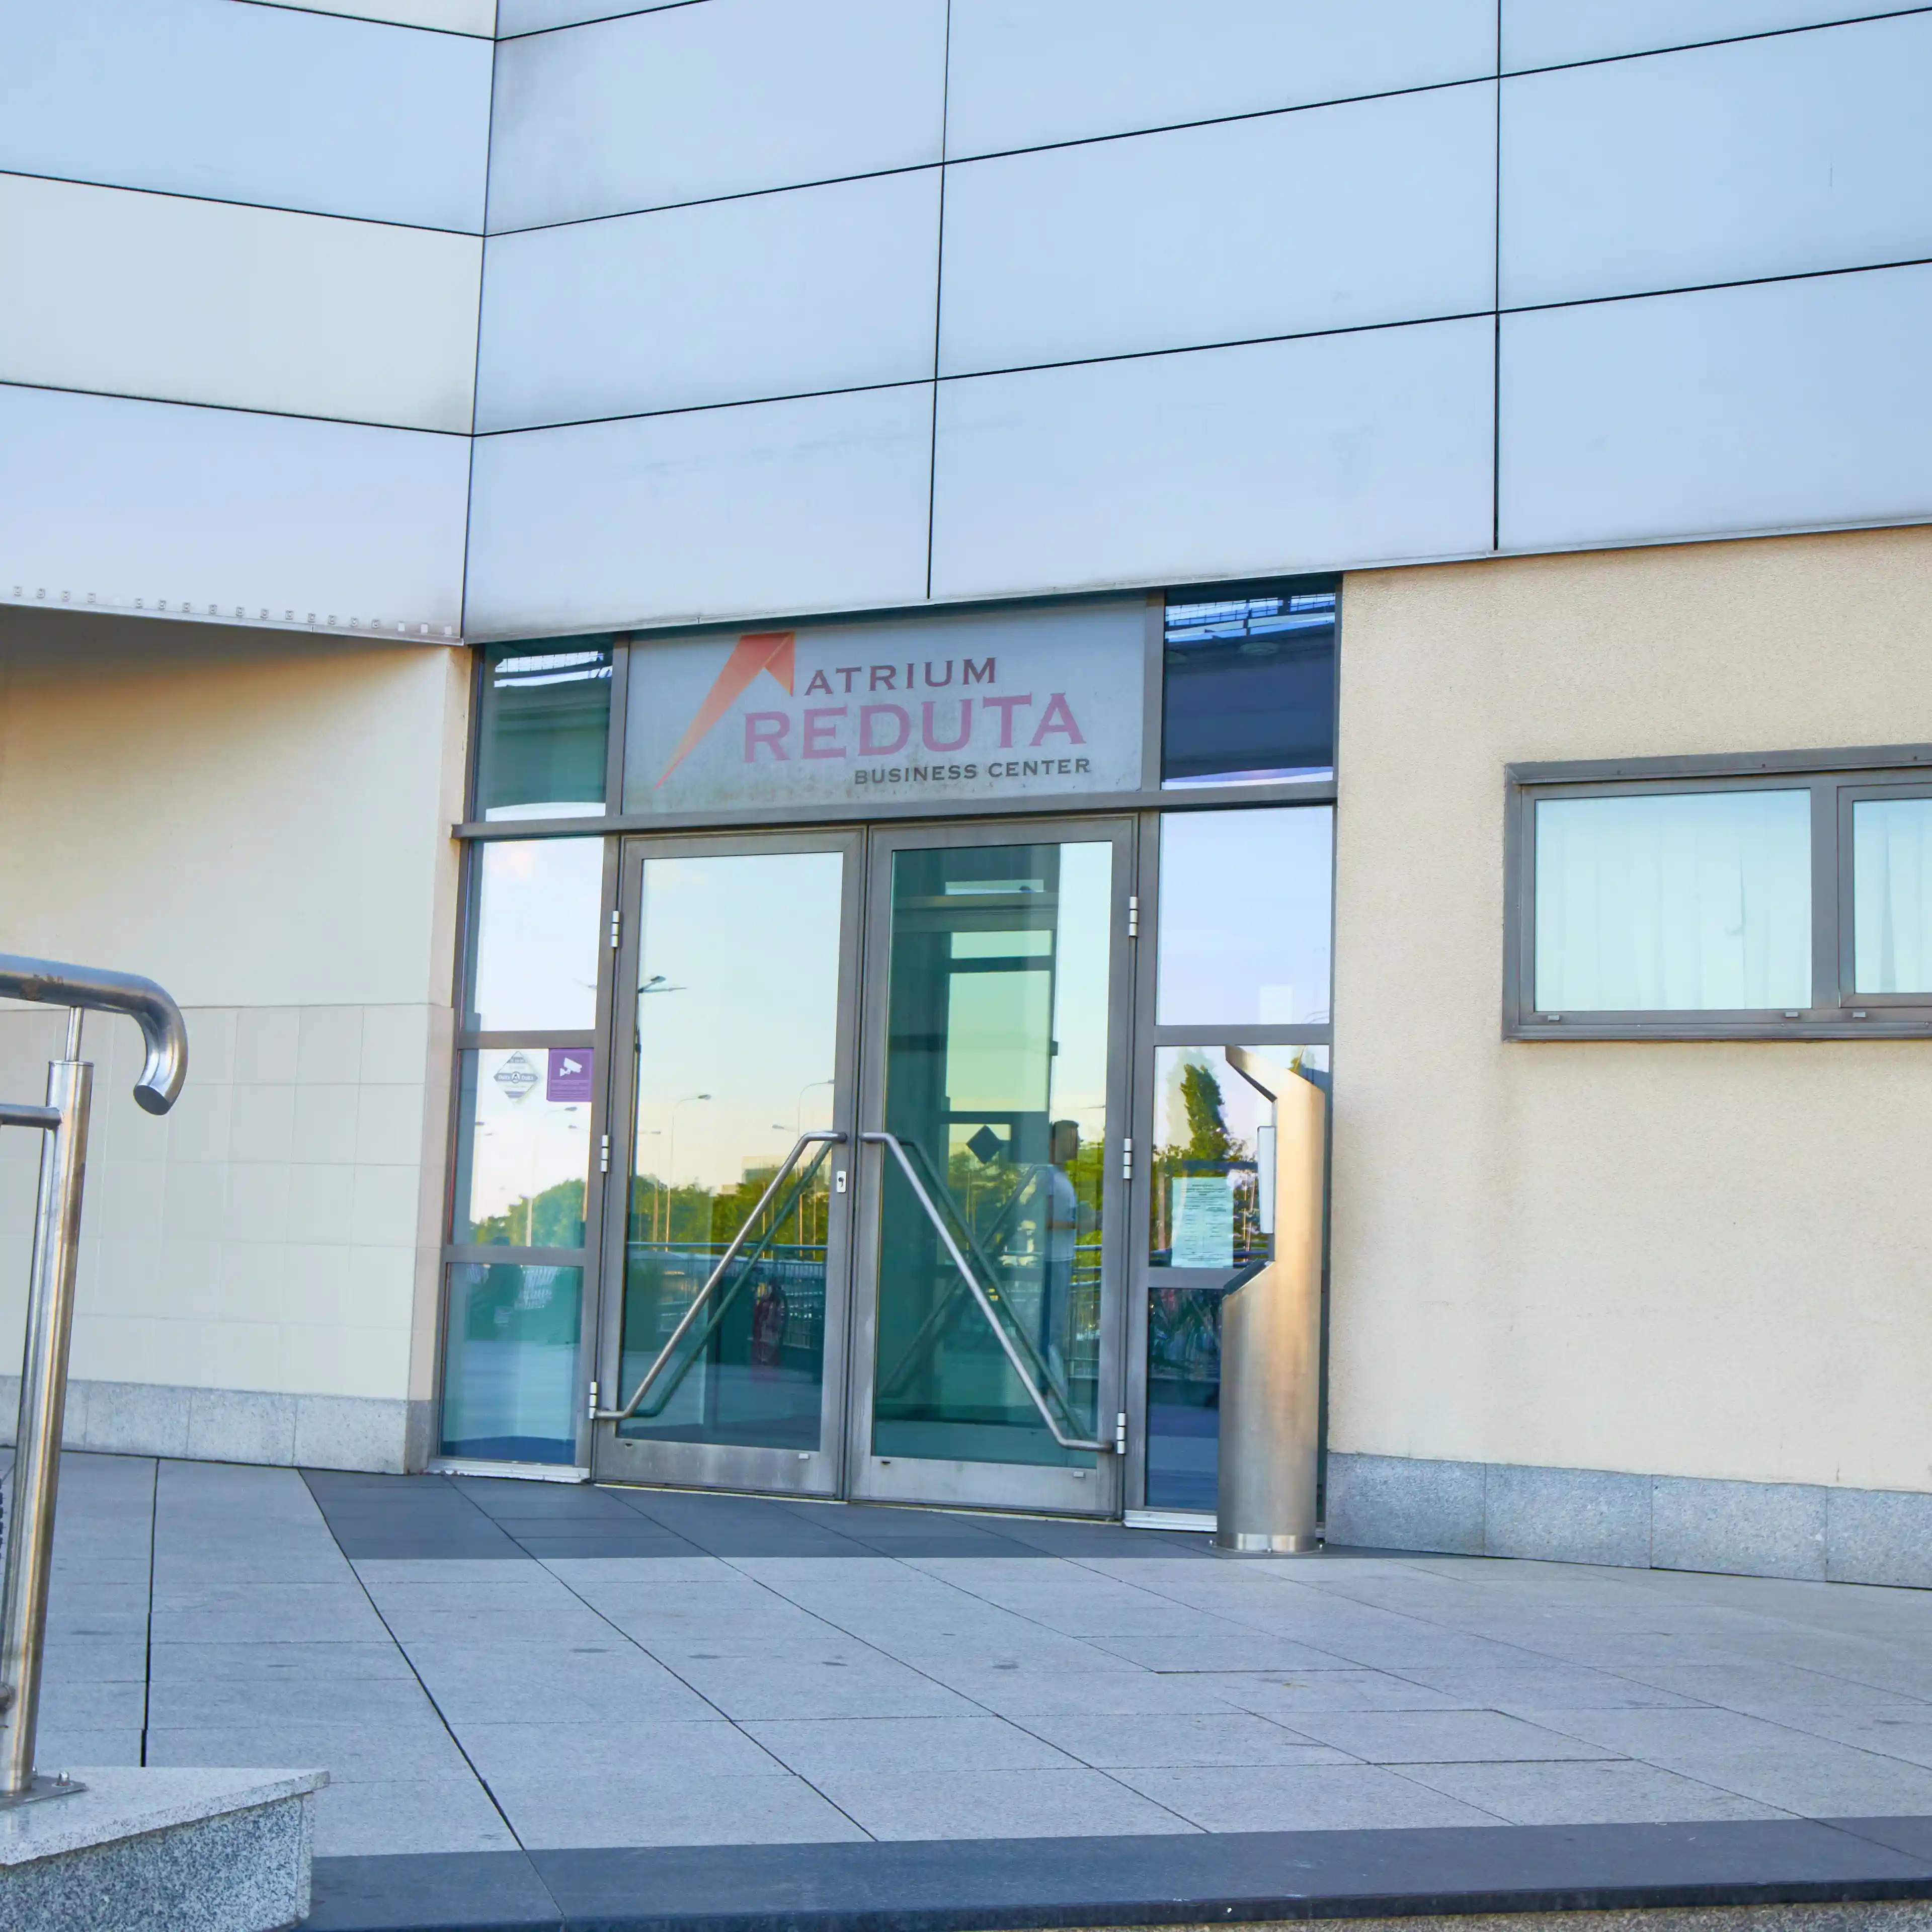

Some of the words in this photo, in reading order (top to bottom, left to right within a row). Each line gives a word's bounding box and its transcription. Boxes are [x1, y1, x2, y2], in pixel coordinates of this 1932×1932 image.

[804, 657, 997, 696] ATRIUM
[744, 692, 1087, 763] REDUTA
[855, 764, 977, 784] BUSINESS
[989, 758, 1091, 778] CENTER
